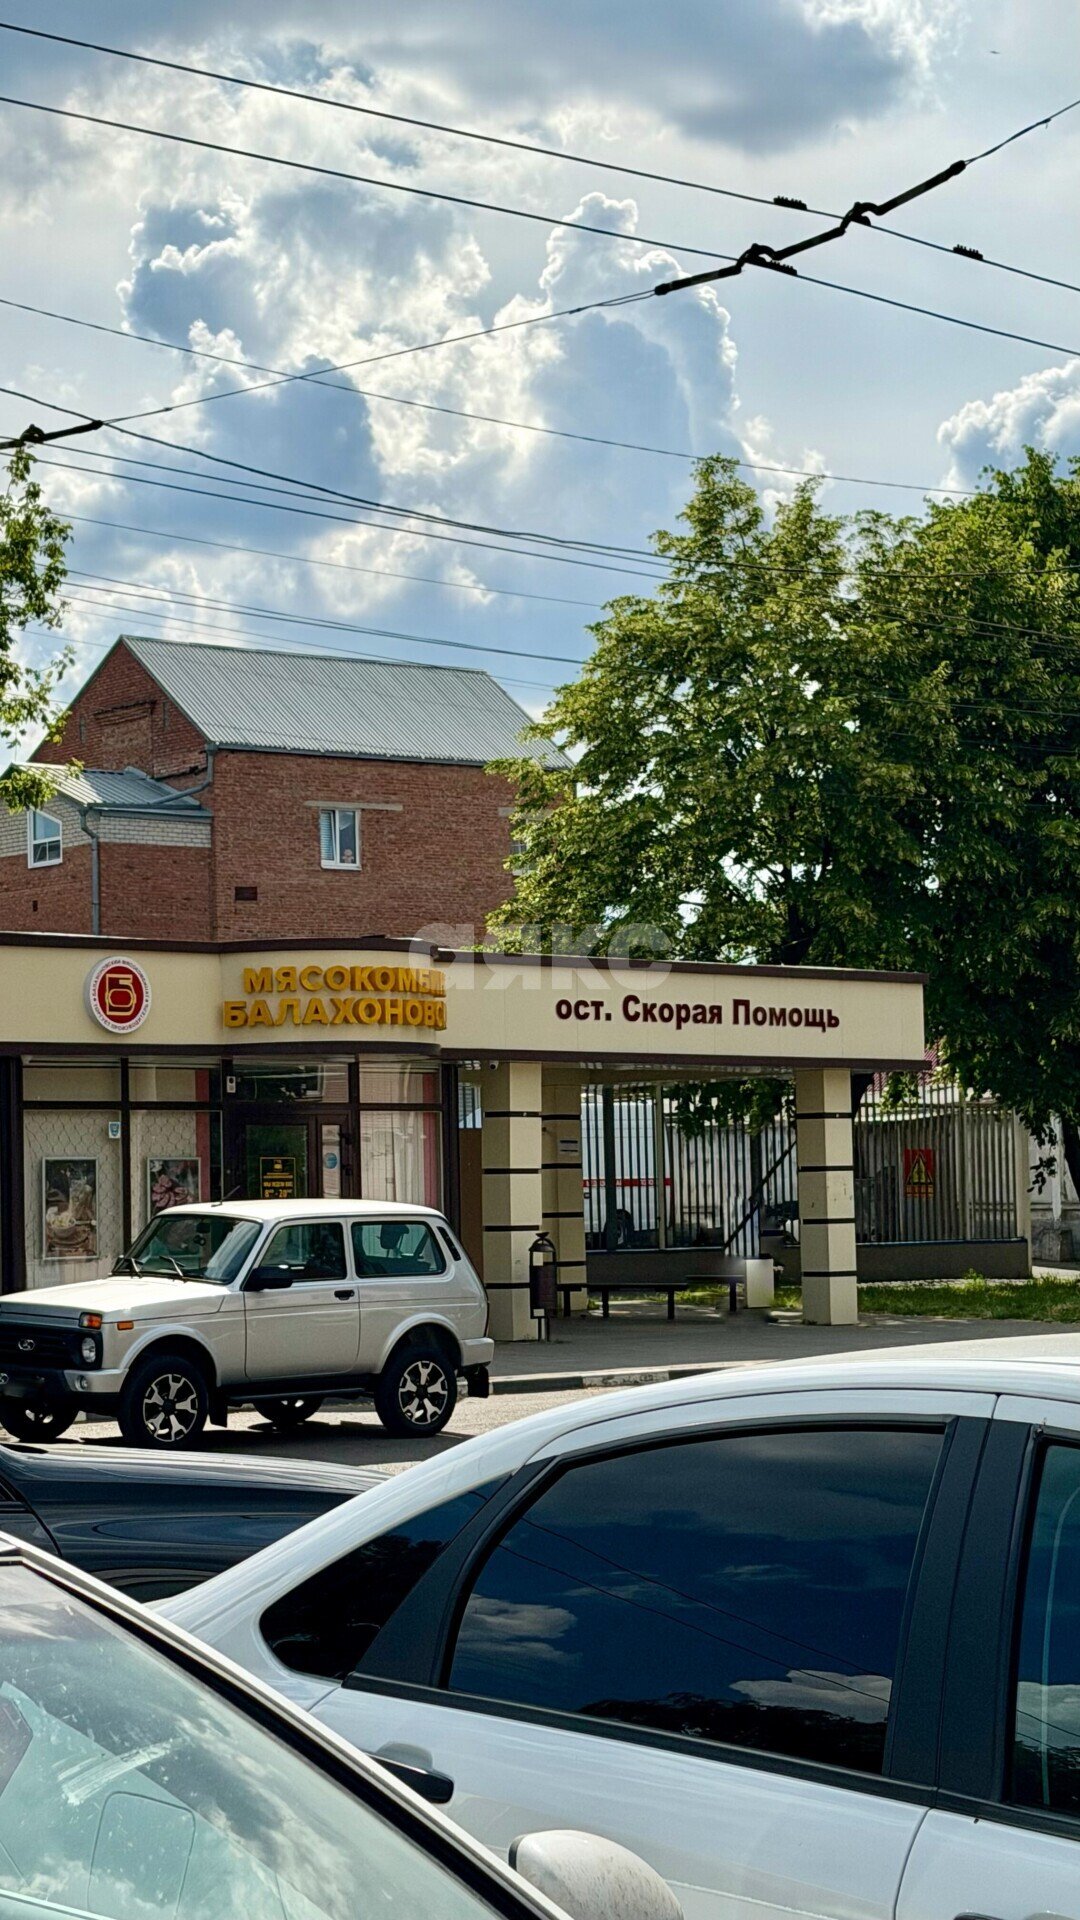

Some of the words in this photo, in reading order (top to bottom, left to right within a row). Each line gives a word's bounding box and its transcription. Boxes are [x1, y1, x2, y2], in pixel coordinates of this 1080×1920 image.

[224, 998, 447, 1031] БАЛАХОНОВС
[555, 999, 612, 1021] ост.
[622, 994, 722, 1030] Скорая
[732, 998, 840, 1033] Помощь
